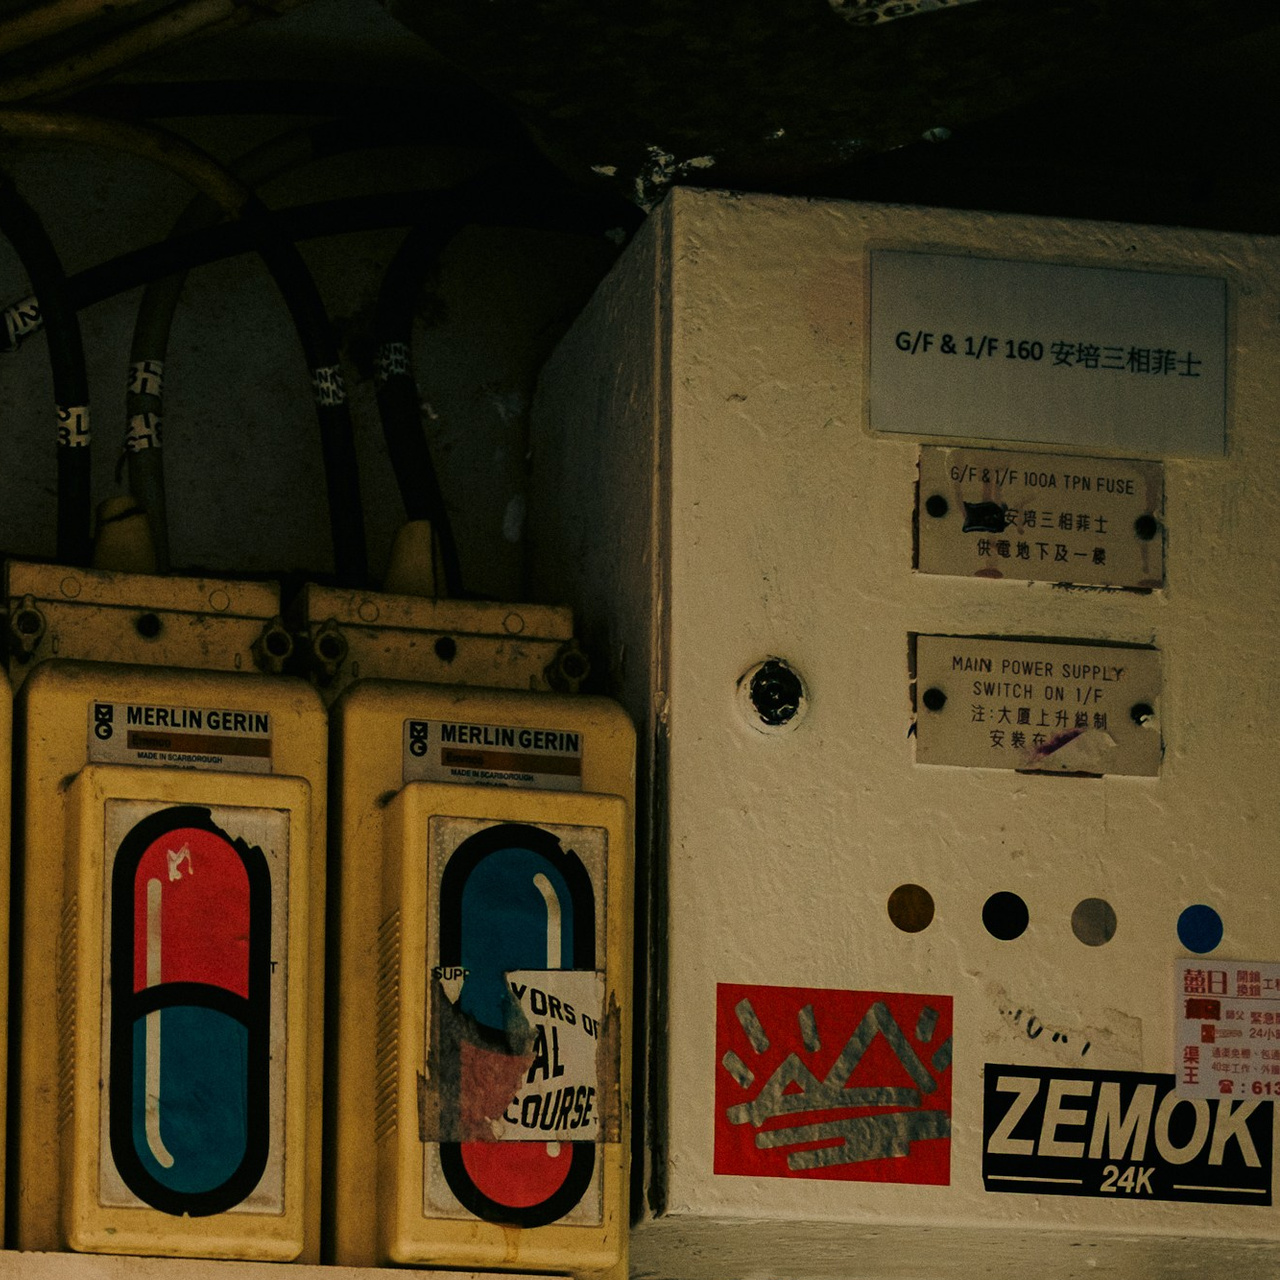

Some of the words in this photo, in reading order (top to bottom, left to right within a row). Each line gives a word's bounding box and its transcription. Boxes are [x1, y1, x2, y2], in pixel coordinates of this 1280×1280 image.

[896, 331, 934, 354] G/F
[941, 334, 956, 354] &
[965, 336, 998, 358] 1/F
[1006, 340, 1043, 360] 160
[1051, 341, 1202, 377] 安培三相菲士
[951, 465, 976, 483] G/F
[1024, 472, 1057, 487] 100A
[1065, 475, 1090, 490] TPN
[1097, 478, 1134, 494] FUSE
[953, 656, 992, 672] MAIN
[1002, 660, 1053, 676] POWER
[1062, 664, 1123, 681] SUPPLY
[973, 681, 1032, 699] SWITCH
[1045, 685, 1064, 700] ON
[1077, 687, 1102, 705] 1/F
[127, 706, 202, 729] MERLIN
[207, 712, 268, 733] GERIN
[442, 724, 514, 747] MERLIN
[519, 730, 578, 751] GERIN
[1183, 1046, 1199, 1084] 渠王
[986, 1076, 1262, 1168] ZEMOK
[1100, 1164, 1156, 1194] 24K
